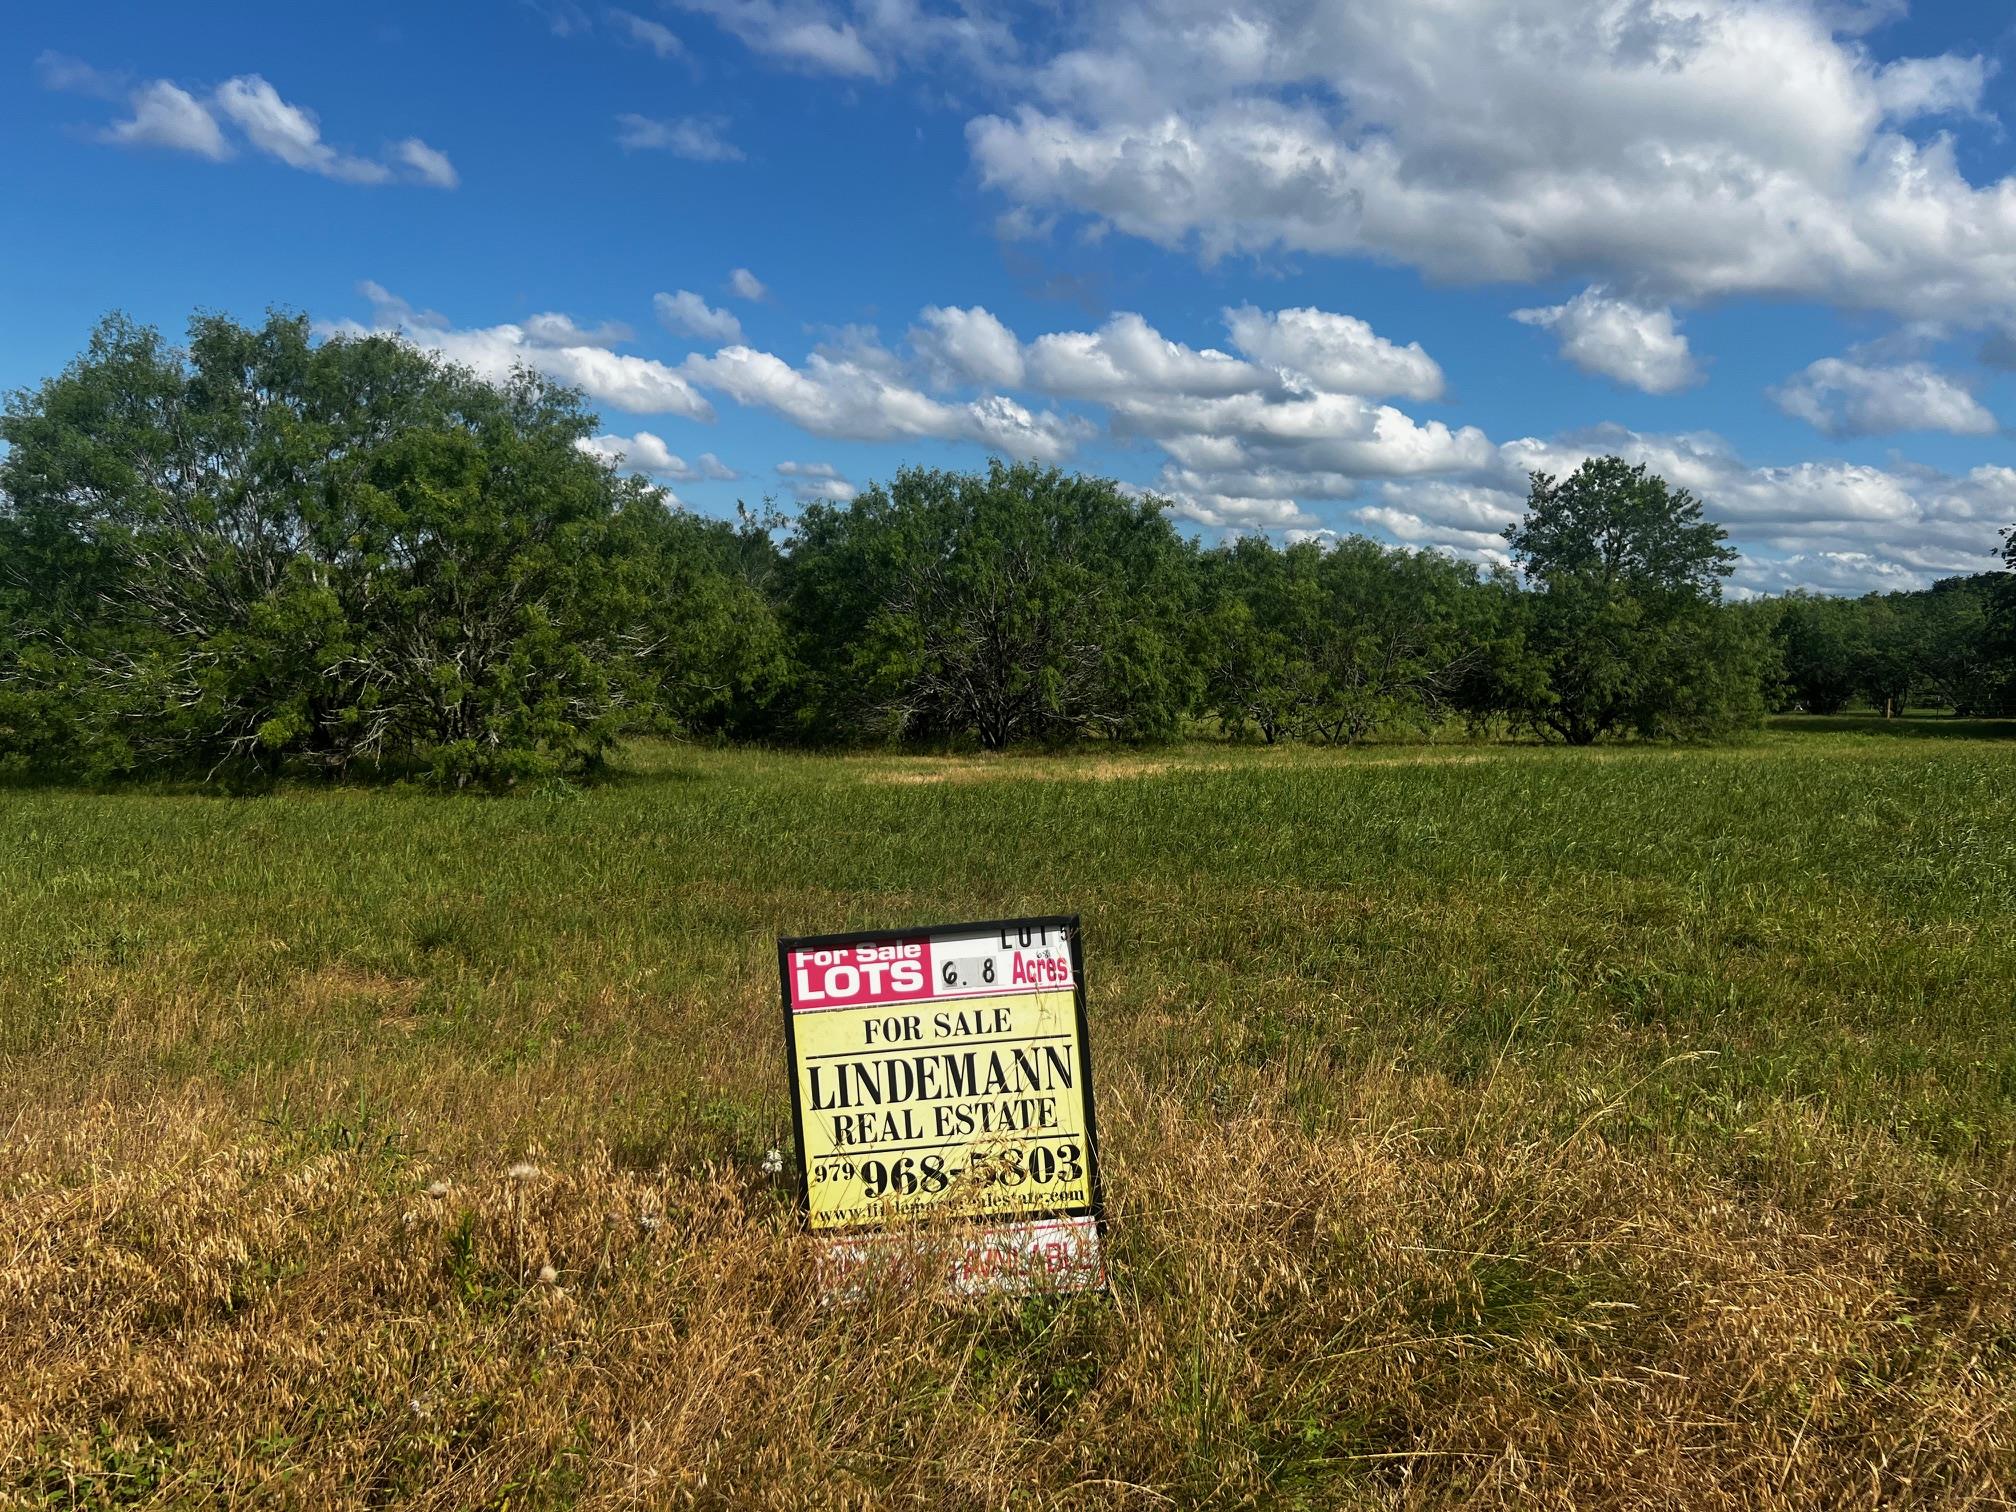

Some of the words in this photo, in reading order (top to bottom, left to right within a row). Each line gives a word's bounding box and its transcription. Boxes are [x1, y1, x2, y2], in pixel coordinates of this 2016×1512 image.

[796, 948, 848, 968] For
[856, 940, 921, 962] Sale
[1012, 951, 1068, 984] Acres
[797, 960, 923, 1001] LOTS
[864, 1017, 923, 1044] FOR
[934, 1008, 1012, 1037] SALE
[807, 1045, 1073, 1111] LINDEMANN
[832, 1109, 923, 1146] REAL
[934, 1097, 1058, 1137] ESTATE
[814, 1163, 854, 1183] 979
[861, 1144, 1083, 1198] 968-5803
